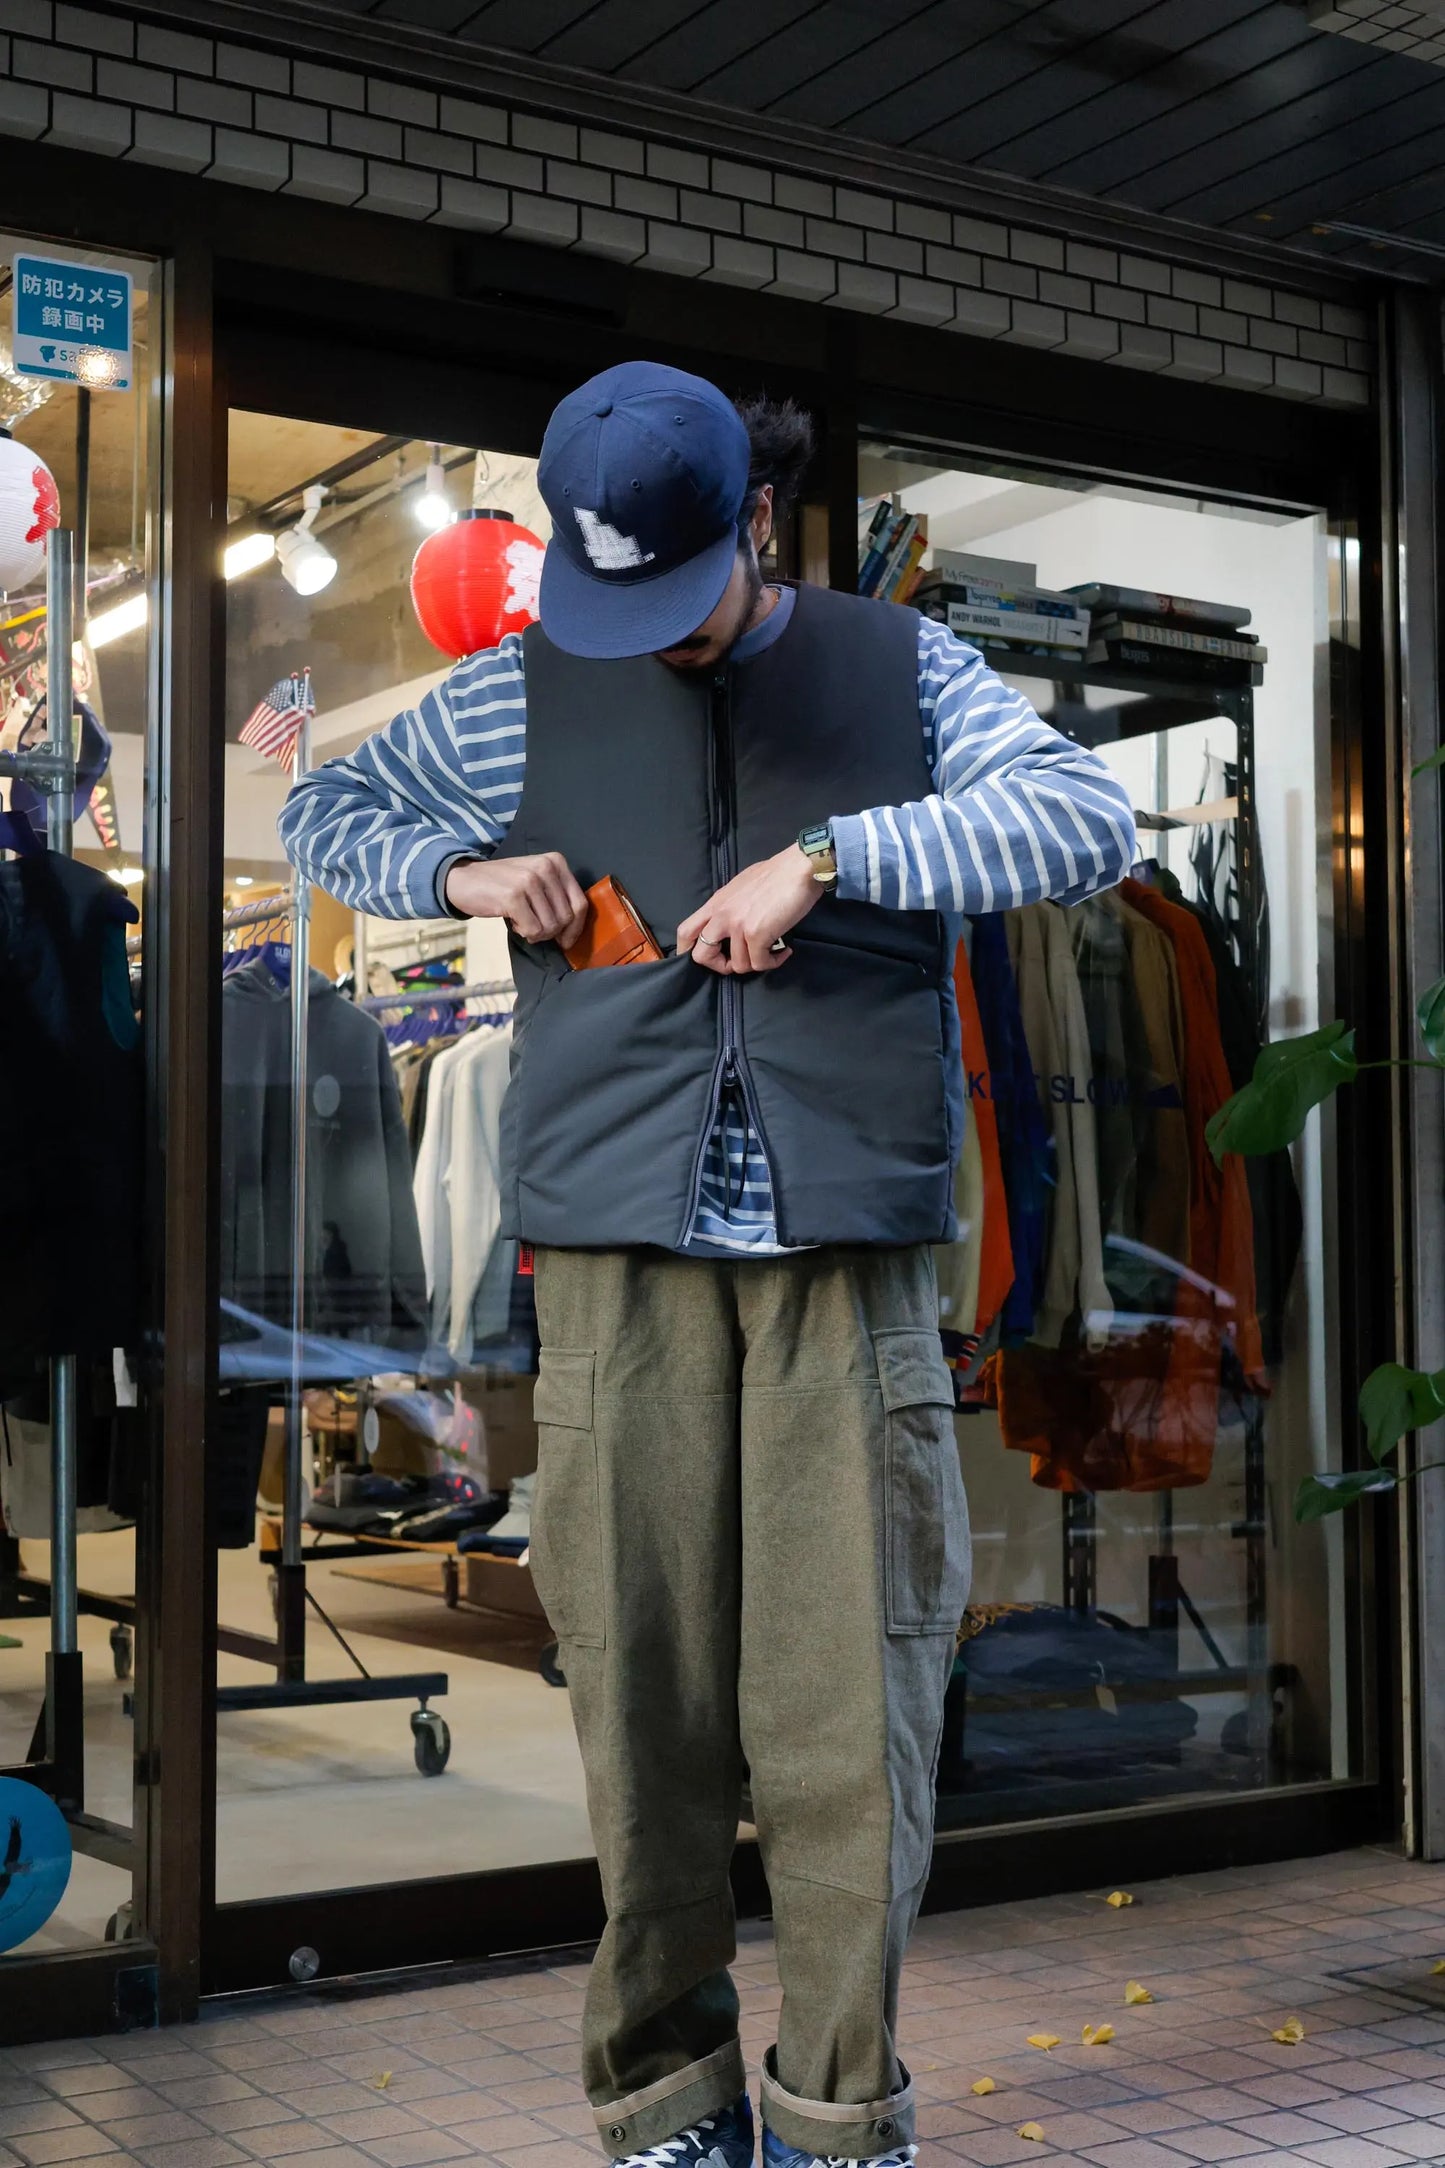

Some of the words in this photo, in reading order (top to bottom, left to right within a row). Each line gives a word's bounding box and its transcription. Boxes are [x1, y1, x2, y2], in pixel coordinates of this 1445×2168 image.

[21, 273, 124, 308] 防犯カメラ
[41, 305, 105, 334] 録画中
[951, 610, 970, 622] ANDY
[972, 614, 1002, 627] WARHOL
[1050, 1074, 1130, 1105] SLOW
